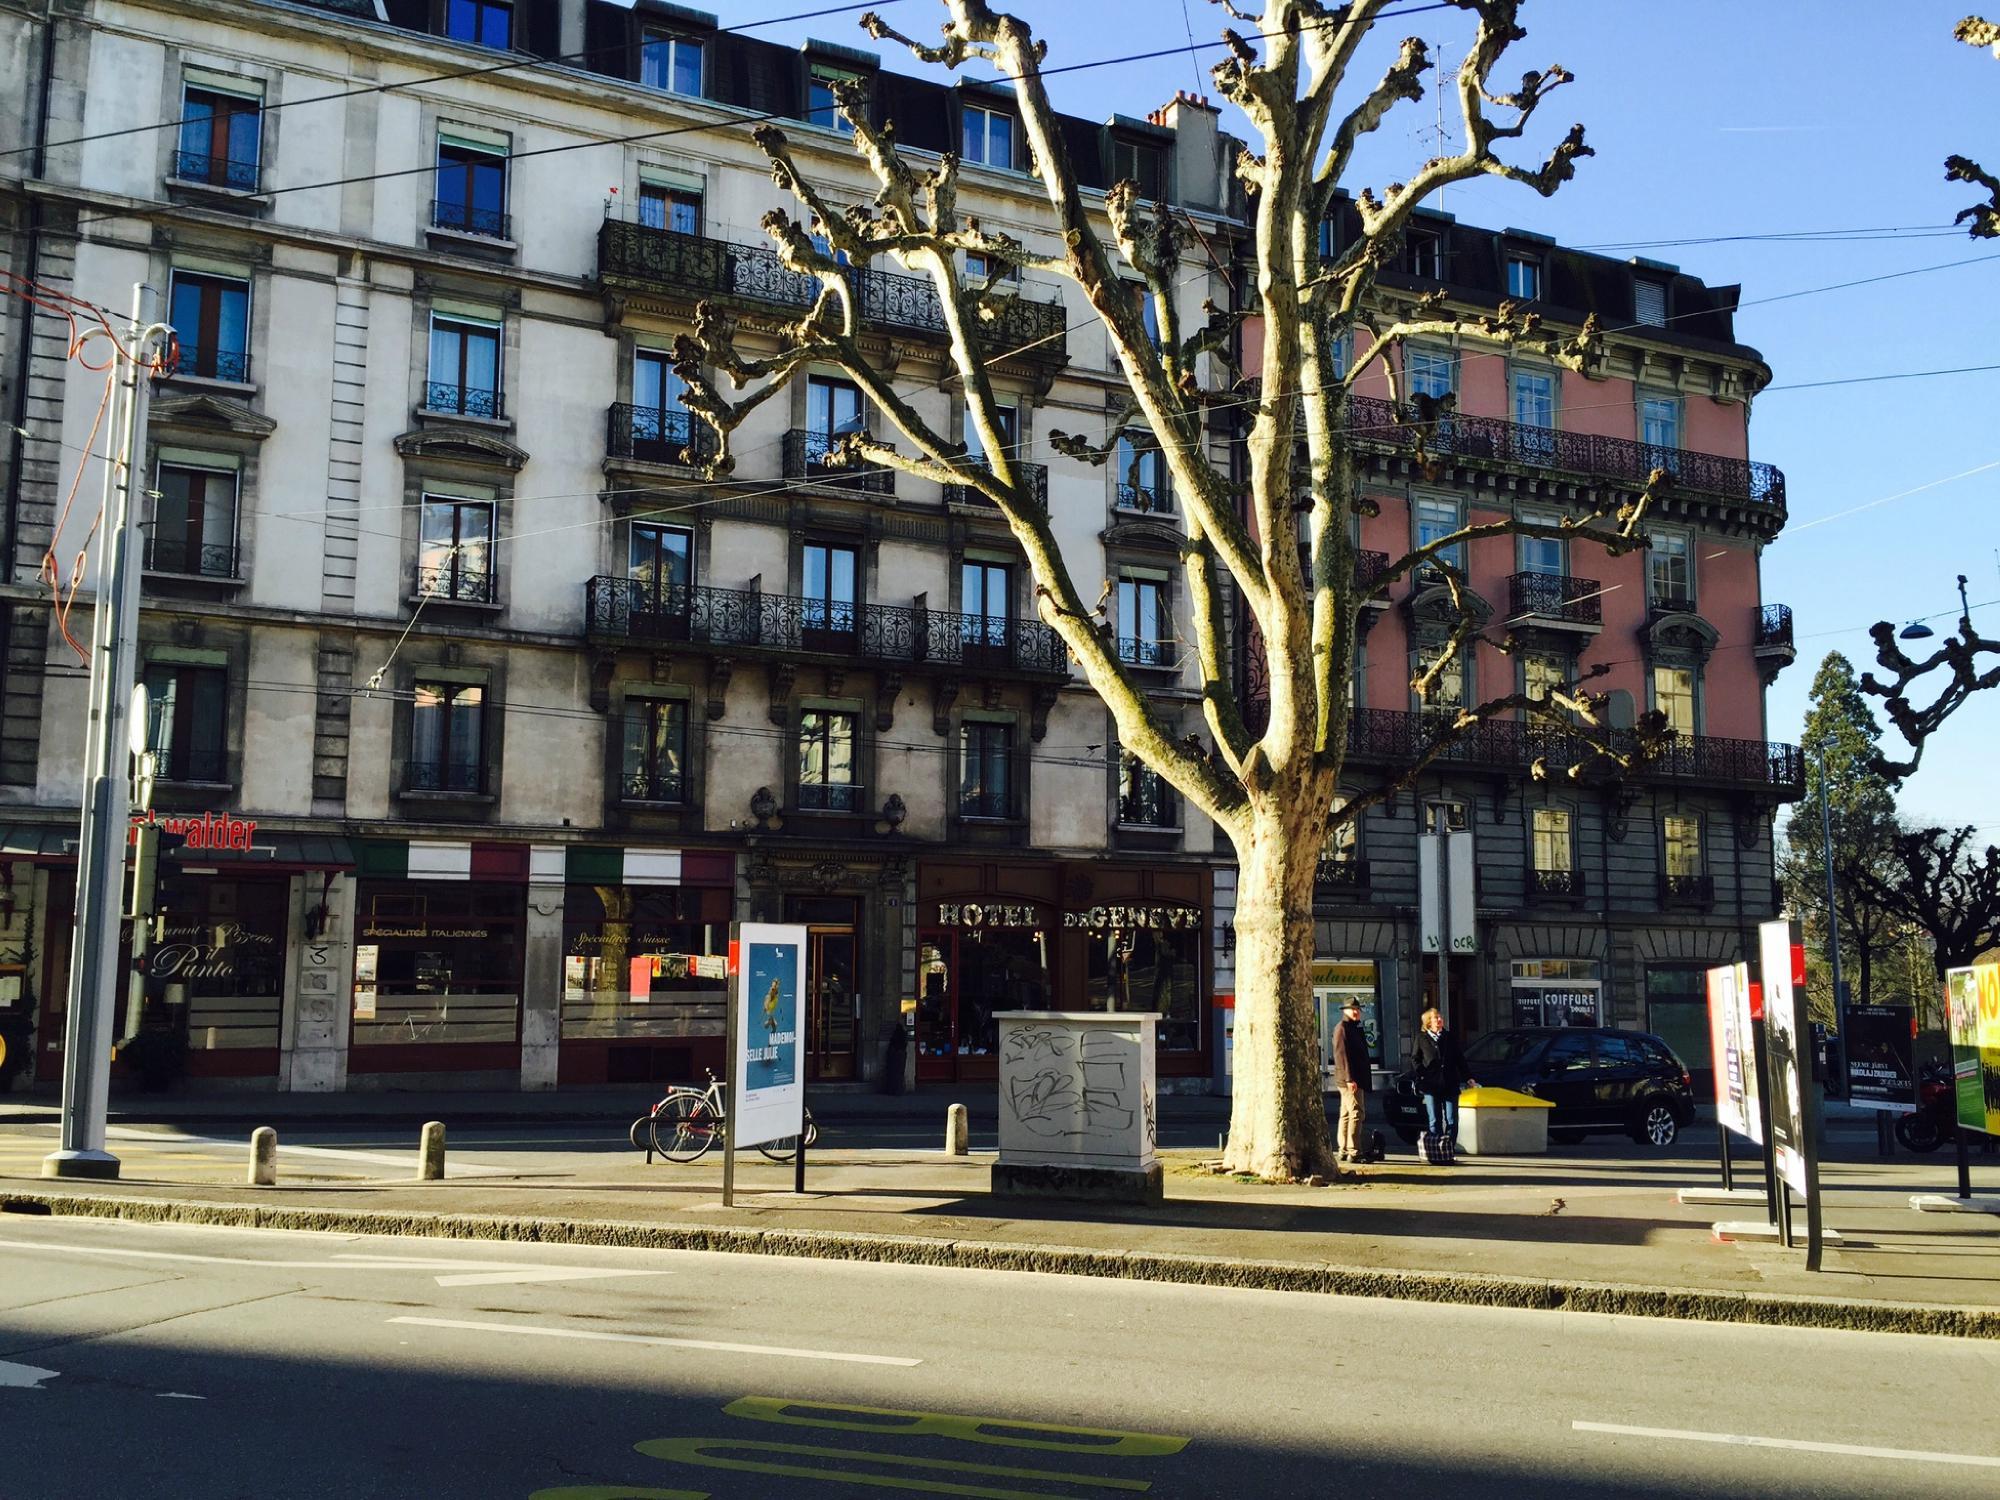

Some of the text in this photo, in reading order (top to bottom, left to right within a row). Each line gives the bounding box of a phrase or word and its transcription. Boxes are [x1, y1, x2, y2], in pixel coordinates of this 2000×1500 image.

[939, 903, 1040, 927] HOTEL
[150, 943, 234, 978] Punto
[1544, 994, 1595, 1006] COIFFURE
[746, 1045, 779, 1062] SELLE JULIE
